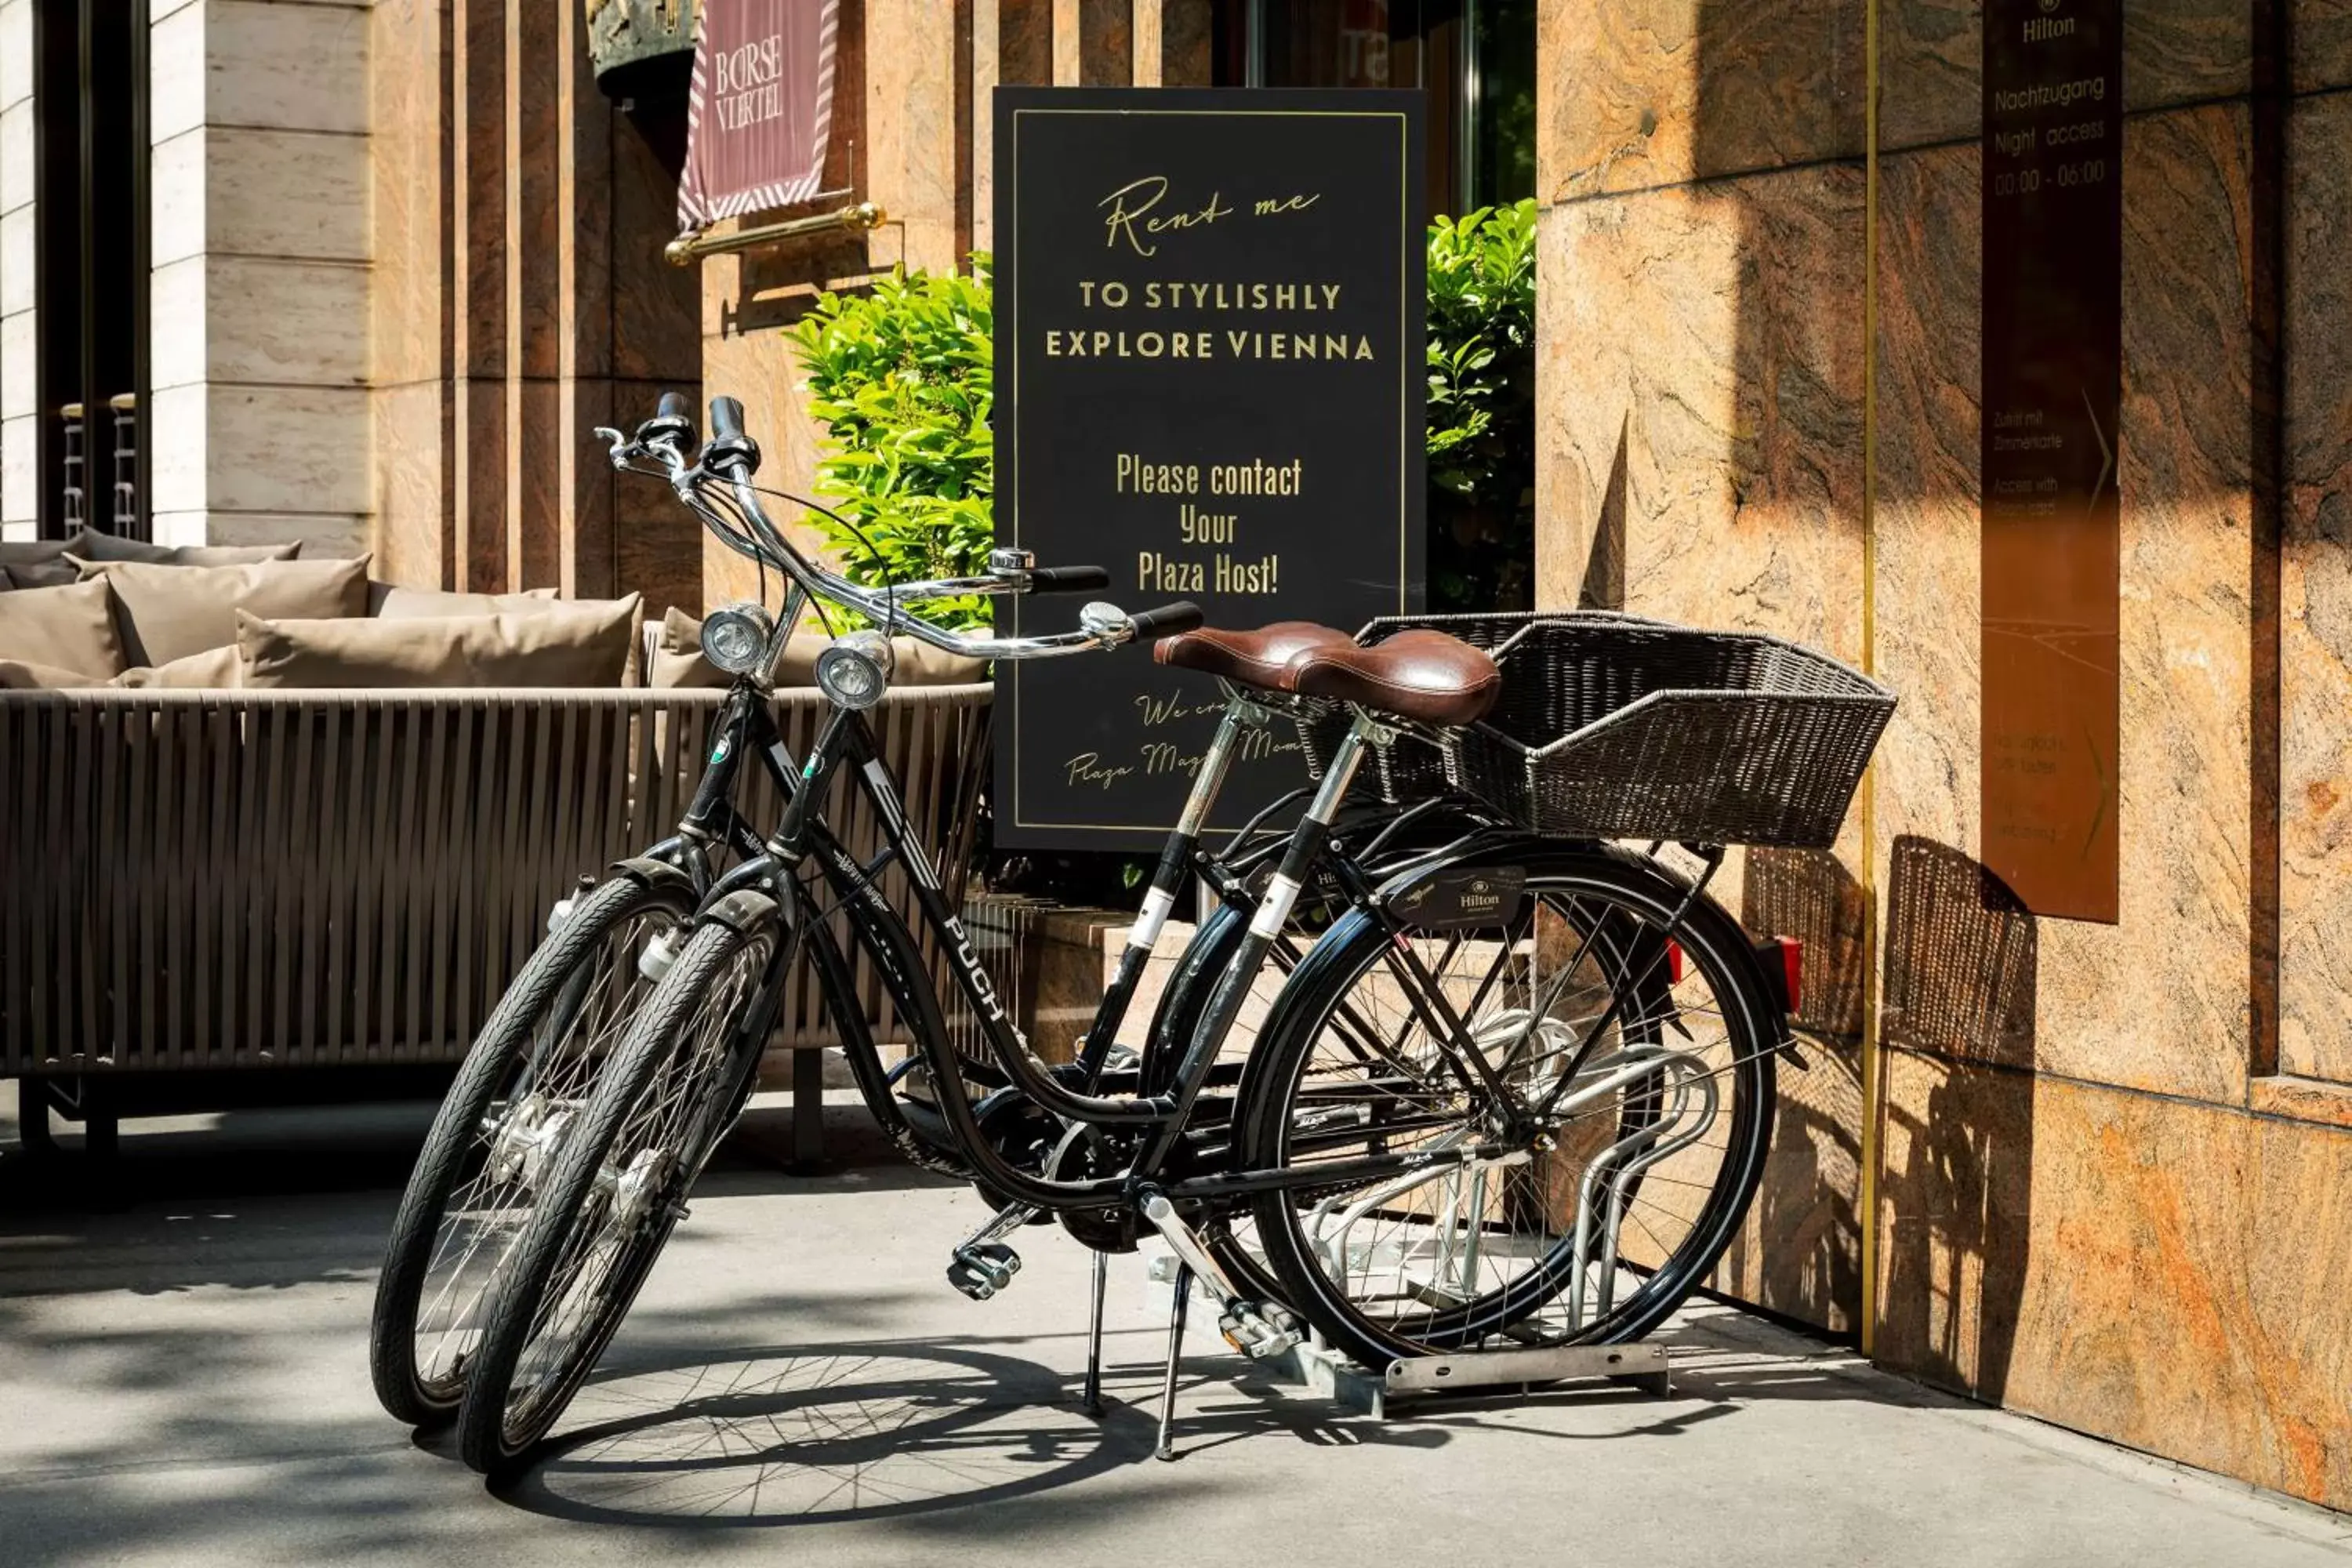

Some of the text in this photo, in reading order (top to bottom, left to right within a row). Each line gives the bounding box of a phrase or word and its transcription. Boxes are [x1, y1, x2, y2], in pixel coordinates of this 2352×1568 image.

[2023, 17, 2074, 43] Hilton
[715, 84, 782, 131] VIERTEL
[1995, 77, 2104, 112] Nachtzugang
[1995, 120, 2104, 157] Night access
[1995, 169, 2039, 195] 00:00
[2058, 160, 2104, 187] 06:00
[1098, 176, 1320, 256] Rent me
[1079, 281, 1341, 310] TO STYLISHLY
[1046, 330, 1374, 360] EXPLORE VIENNA
[1116, 454, 1301, 496] Please contact
[1180, 504, 1237, 544] Your
[1139, 551, 1279, 593] Plaza Host!
[1134, 689, 1189, 727] We
[1064, 728, 1304, 789] Plaza Mag Mom
[1461, 895, 1500, 909] Hilton
[942, 915, 1004, 1022] PUCH
